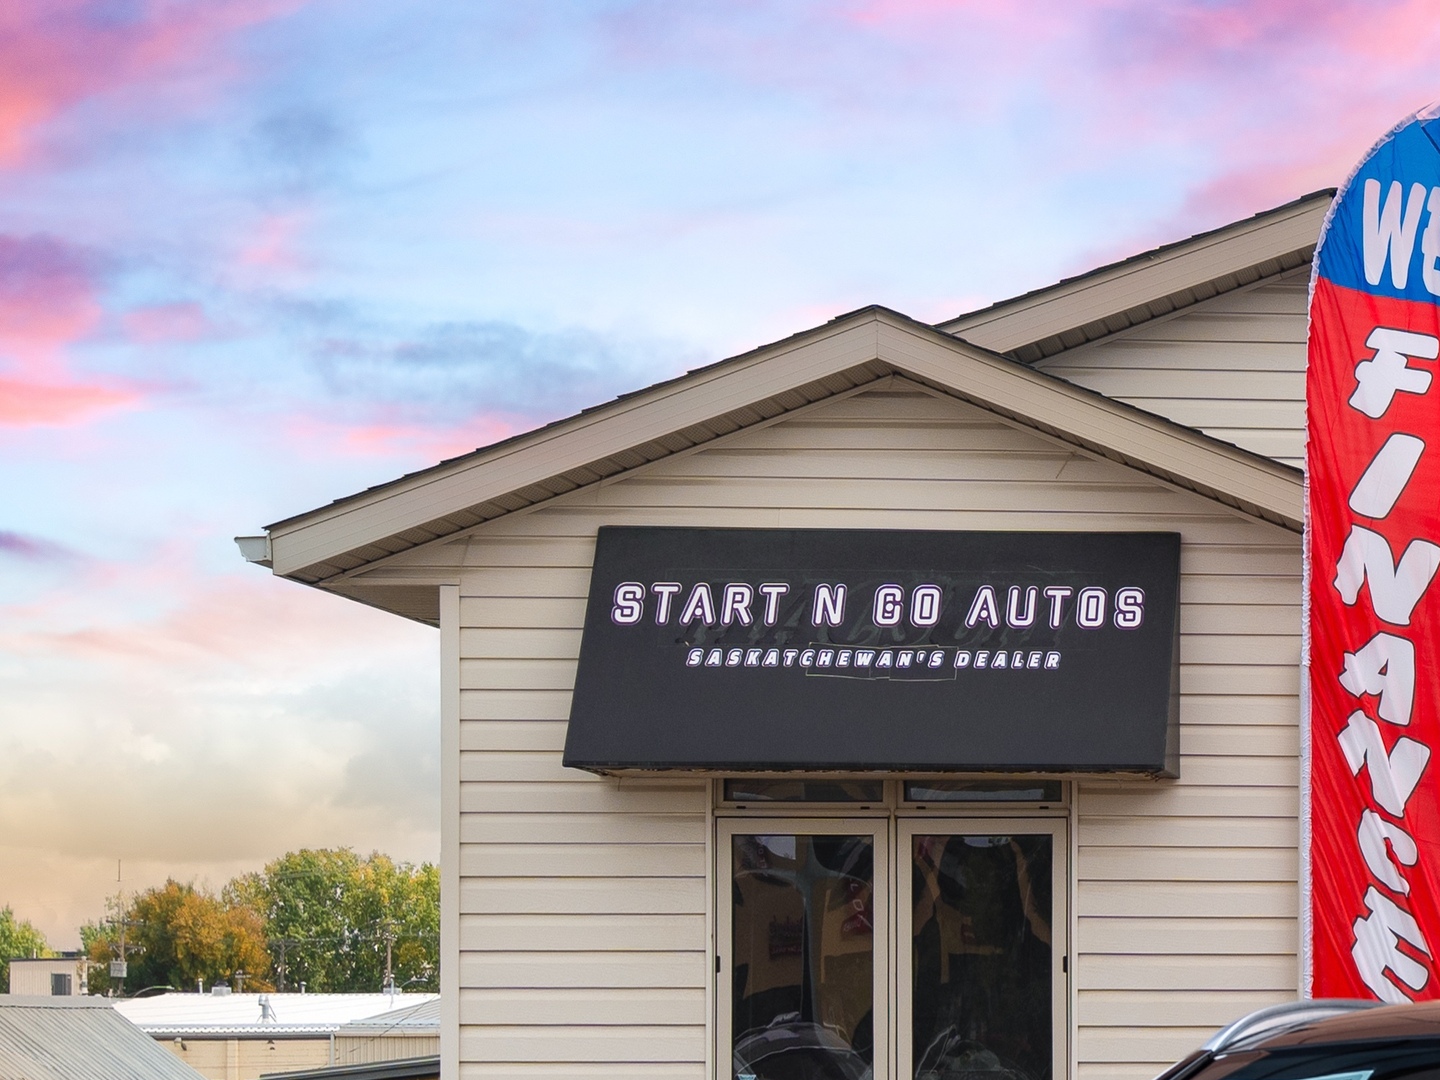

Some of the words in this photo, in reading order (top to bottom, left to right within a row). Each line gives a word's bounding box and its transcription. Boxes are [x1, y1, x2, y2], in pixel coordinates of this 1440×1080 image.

[611, 581, 790, 629] START
[811, 583, 848, 628] N
[872, 583, 944, 629] GO
[964, 584, 1146, 630] AUTOS
[686, 648, 946, 670] SASKATCHEWAN'S
[953, 649, 1062, 671] DEALER
